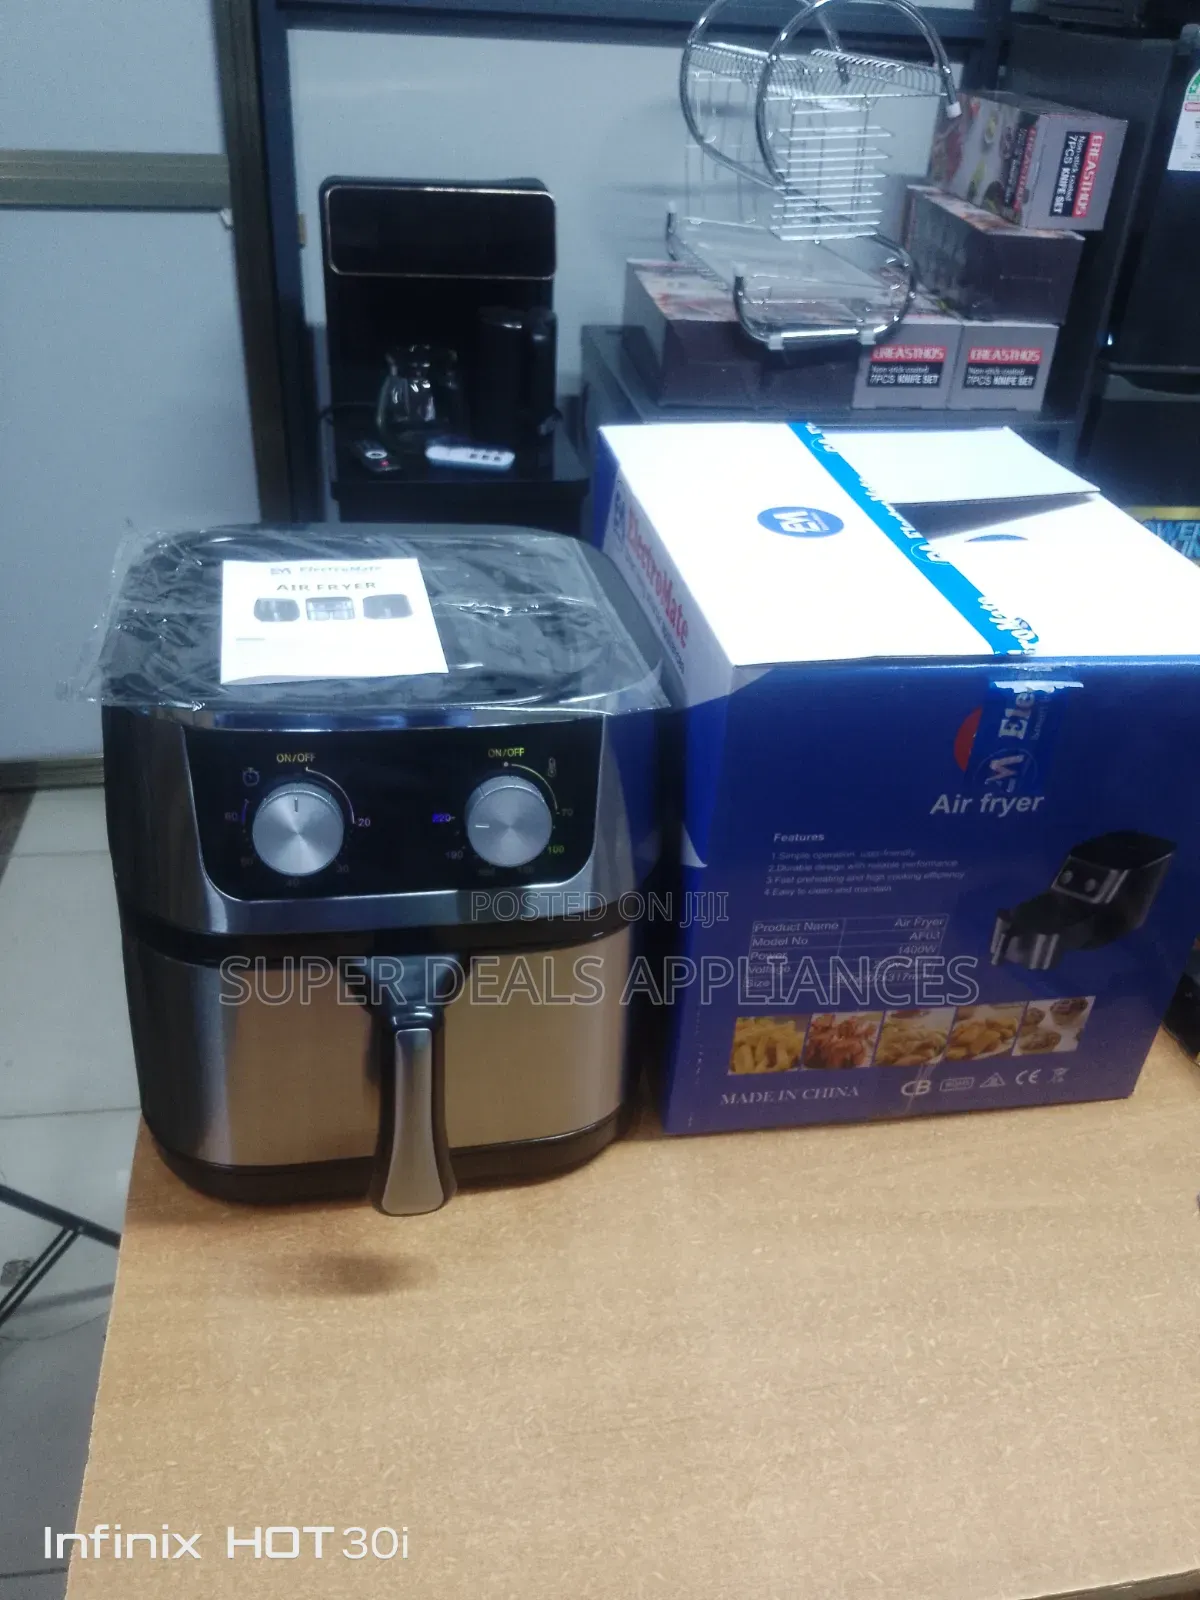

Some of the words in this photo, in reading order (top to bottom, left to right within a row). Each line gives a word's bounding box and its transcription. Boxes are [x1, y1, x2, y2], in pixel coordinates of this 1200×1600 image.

[1063, 134, 1078, 164] 7PCS
[1056, 167, 1071, 195] KNIFE
[1053, 196, 1065, 214] SET
[897, 373, 921, 384] KNIFE
[922, 374, 940, 384] SET
[993, 375, 1017, 386] KNIFE
[276, 583, 310, 591] AIR
[317, 582, 376, 591] FRYER
[488, 747, 525, 758] ON/OFF
[276, 753, 316, 764] ON/OFF
[930, 794, 973, 815] Air
[979, 793, 1045, 818] fryer
[358, 817, 371, 827] 20
[773, 832, 825, 843] Features
[902, 859, 959, 870] performance
[846, 873, 864, 882] and
[797, 887, 807, 895] to
[754, 922, 801, 933] Product
[804, 921, 839, 931] Name
[895, 918, 911, 927] Air
[914, 917, 945, 929] Fryer
[752, 936, 788, 947] Model
[791, 936, 809, 945] No
[750, 951, 788, 961] Power
[745, 978, 771, 988] Size
[720, 1091, 775, 1106] MADE
[778, 1089, 797, 1102] IN
[801, 1086, 859, 1100] CHINA
